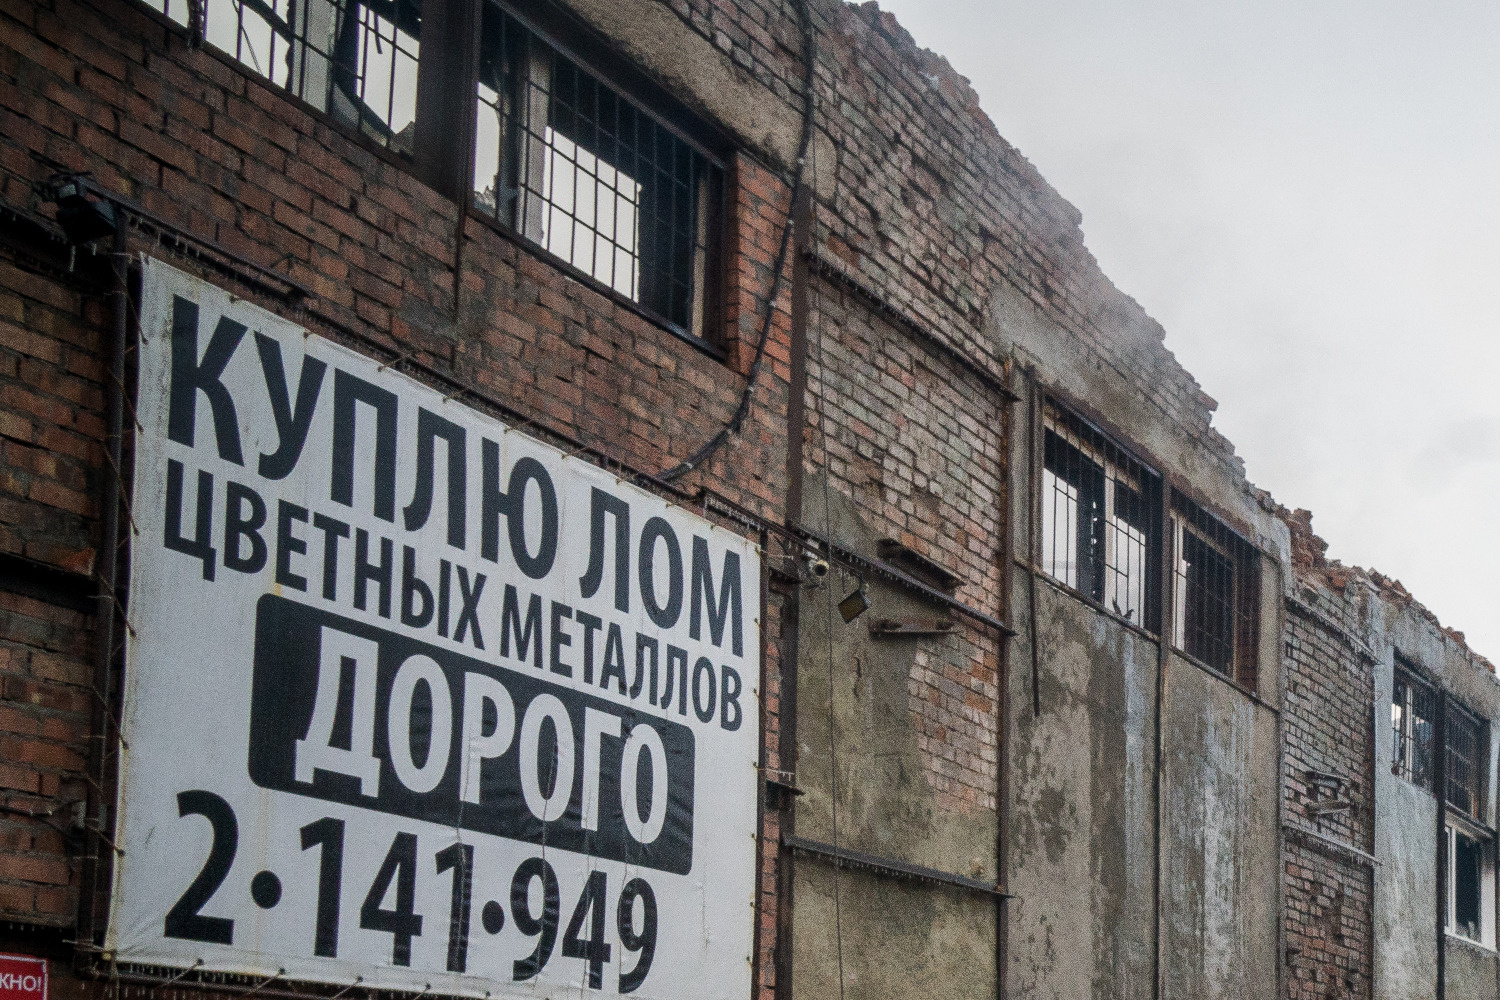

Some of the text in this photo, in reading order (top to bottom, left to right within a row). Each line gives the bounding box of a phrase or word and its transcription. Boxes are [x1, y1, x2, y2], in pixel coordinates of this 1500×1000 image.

[164, 458, 742, 731] ЦВЕТНЫХ МЕТАЛЛОВ
[168, 294, 744, 658] КУПЛЮ ЛОМ
[295, 625, 669, 844] ДОРОГО
